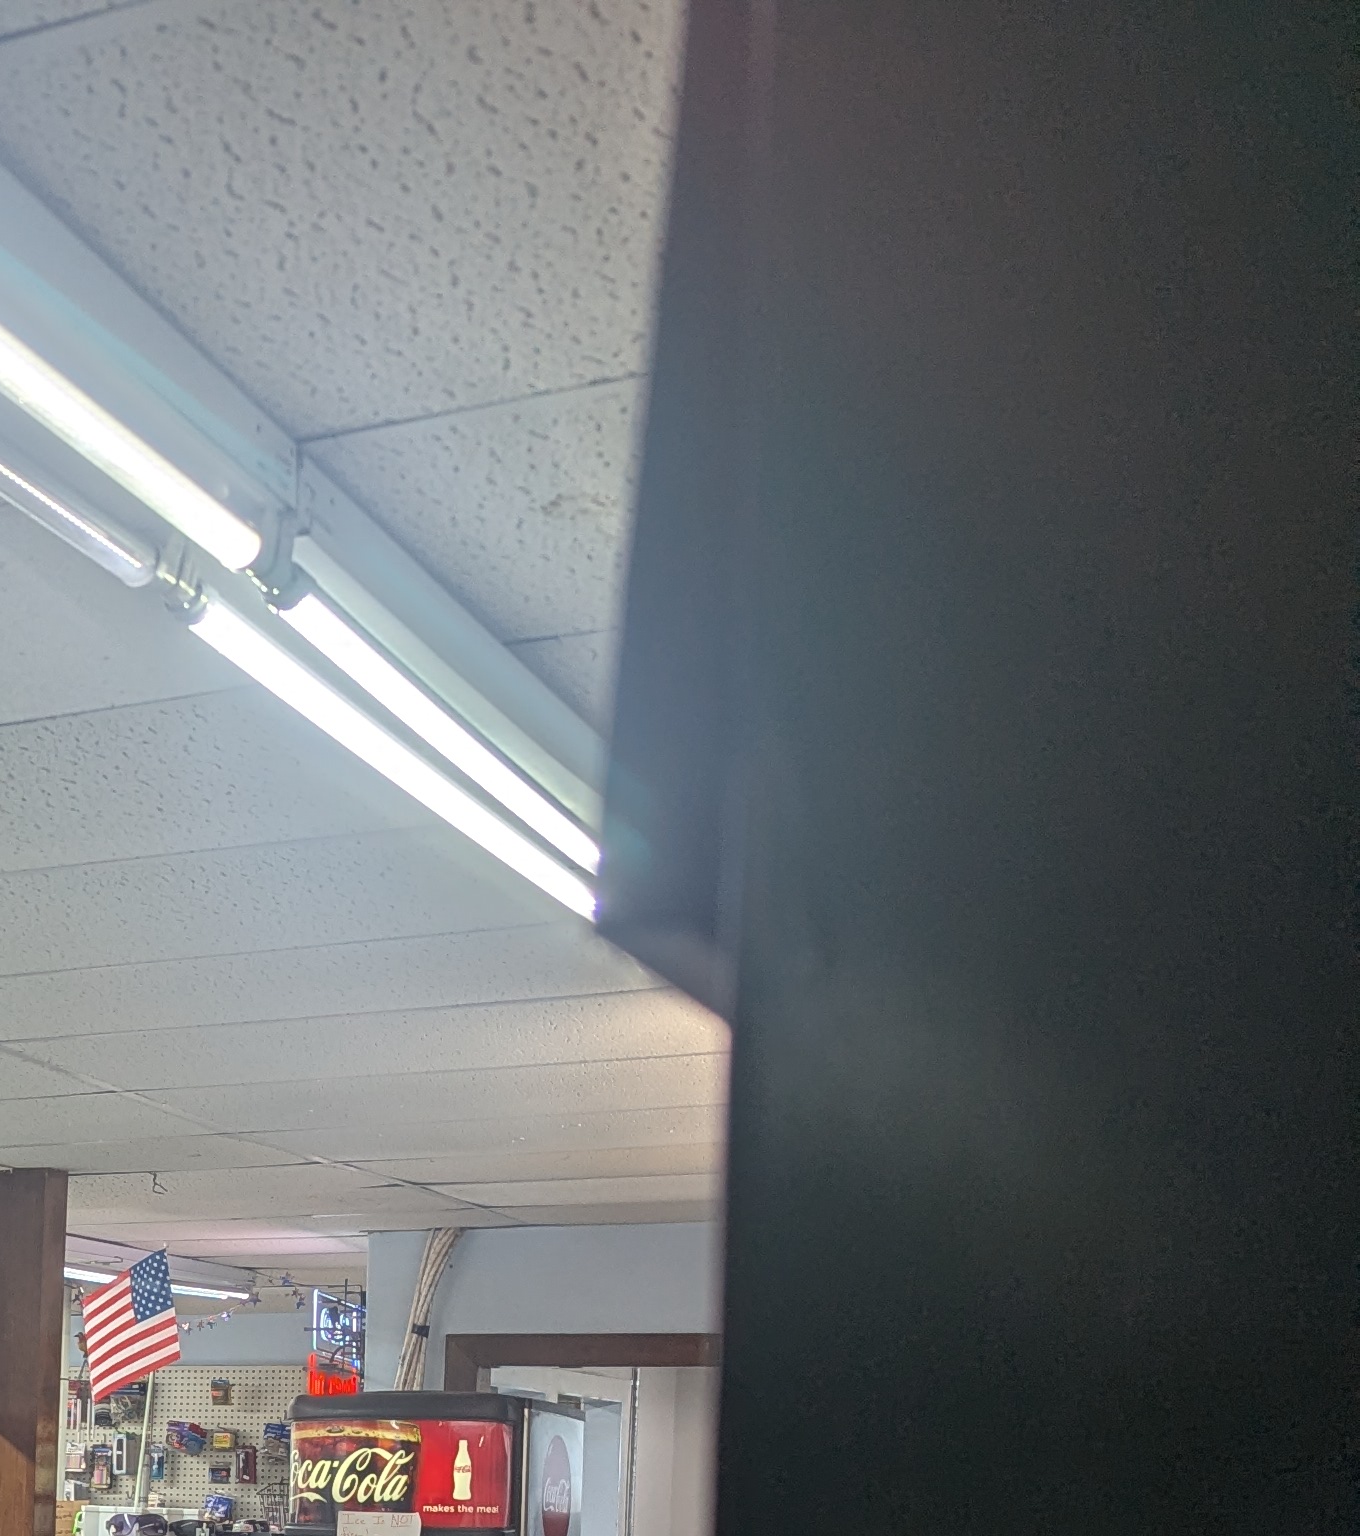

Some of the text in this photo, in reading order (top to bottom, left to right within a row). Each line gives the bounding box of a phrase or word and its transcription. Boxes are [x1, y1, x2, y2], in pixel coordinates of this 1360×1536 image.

[422, 1503, 500, 1514] makes the meal
